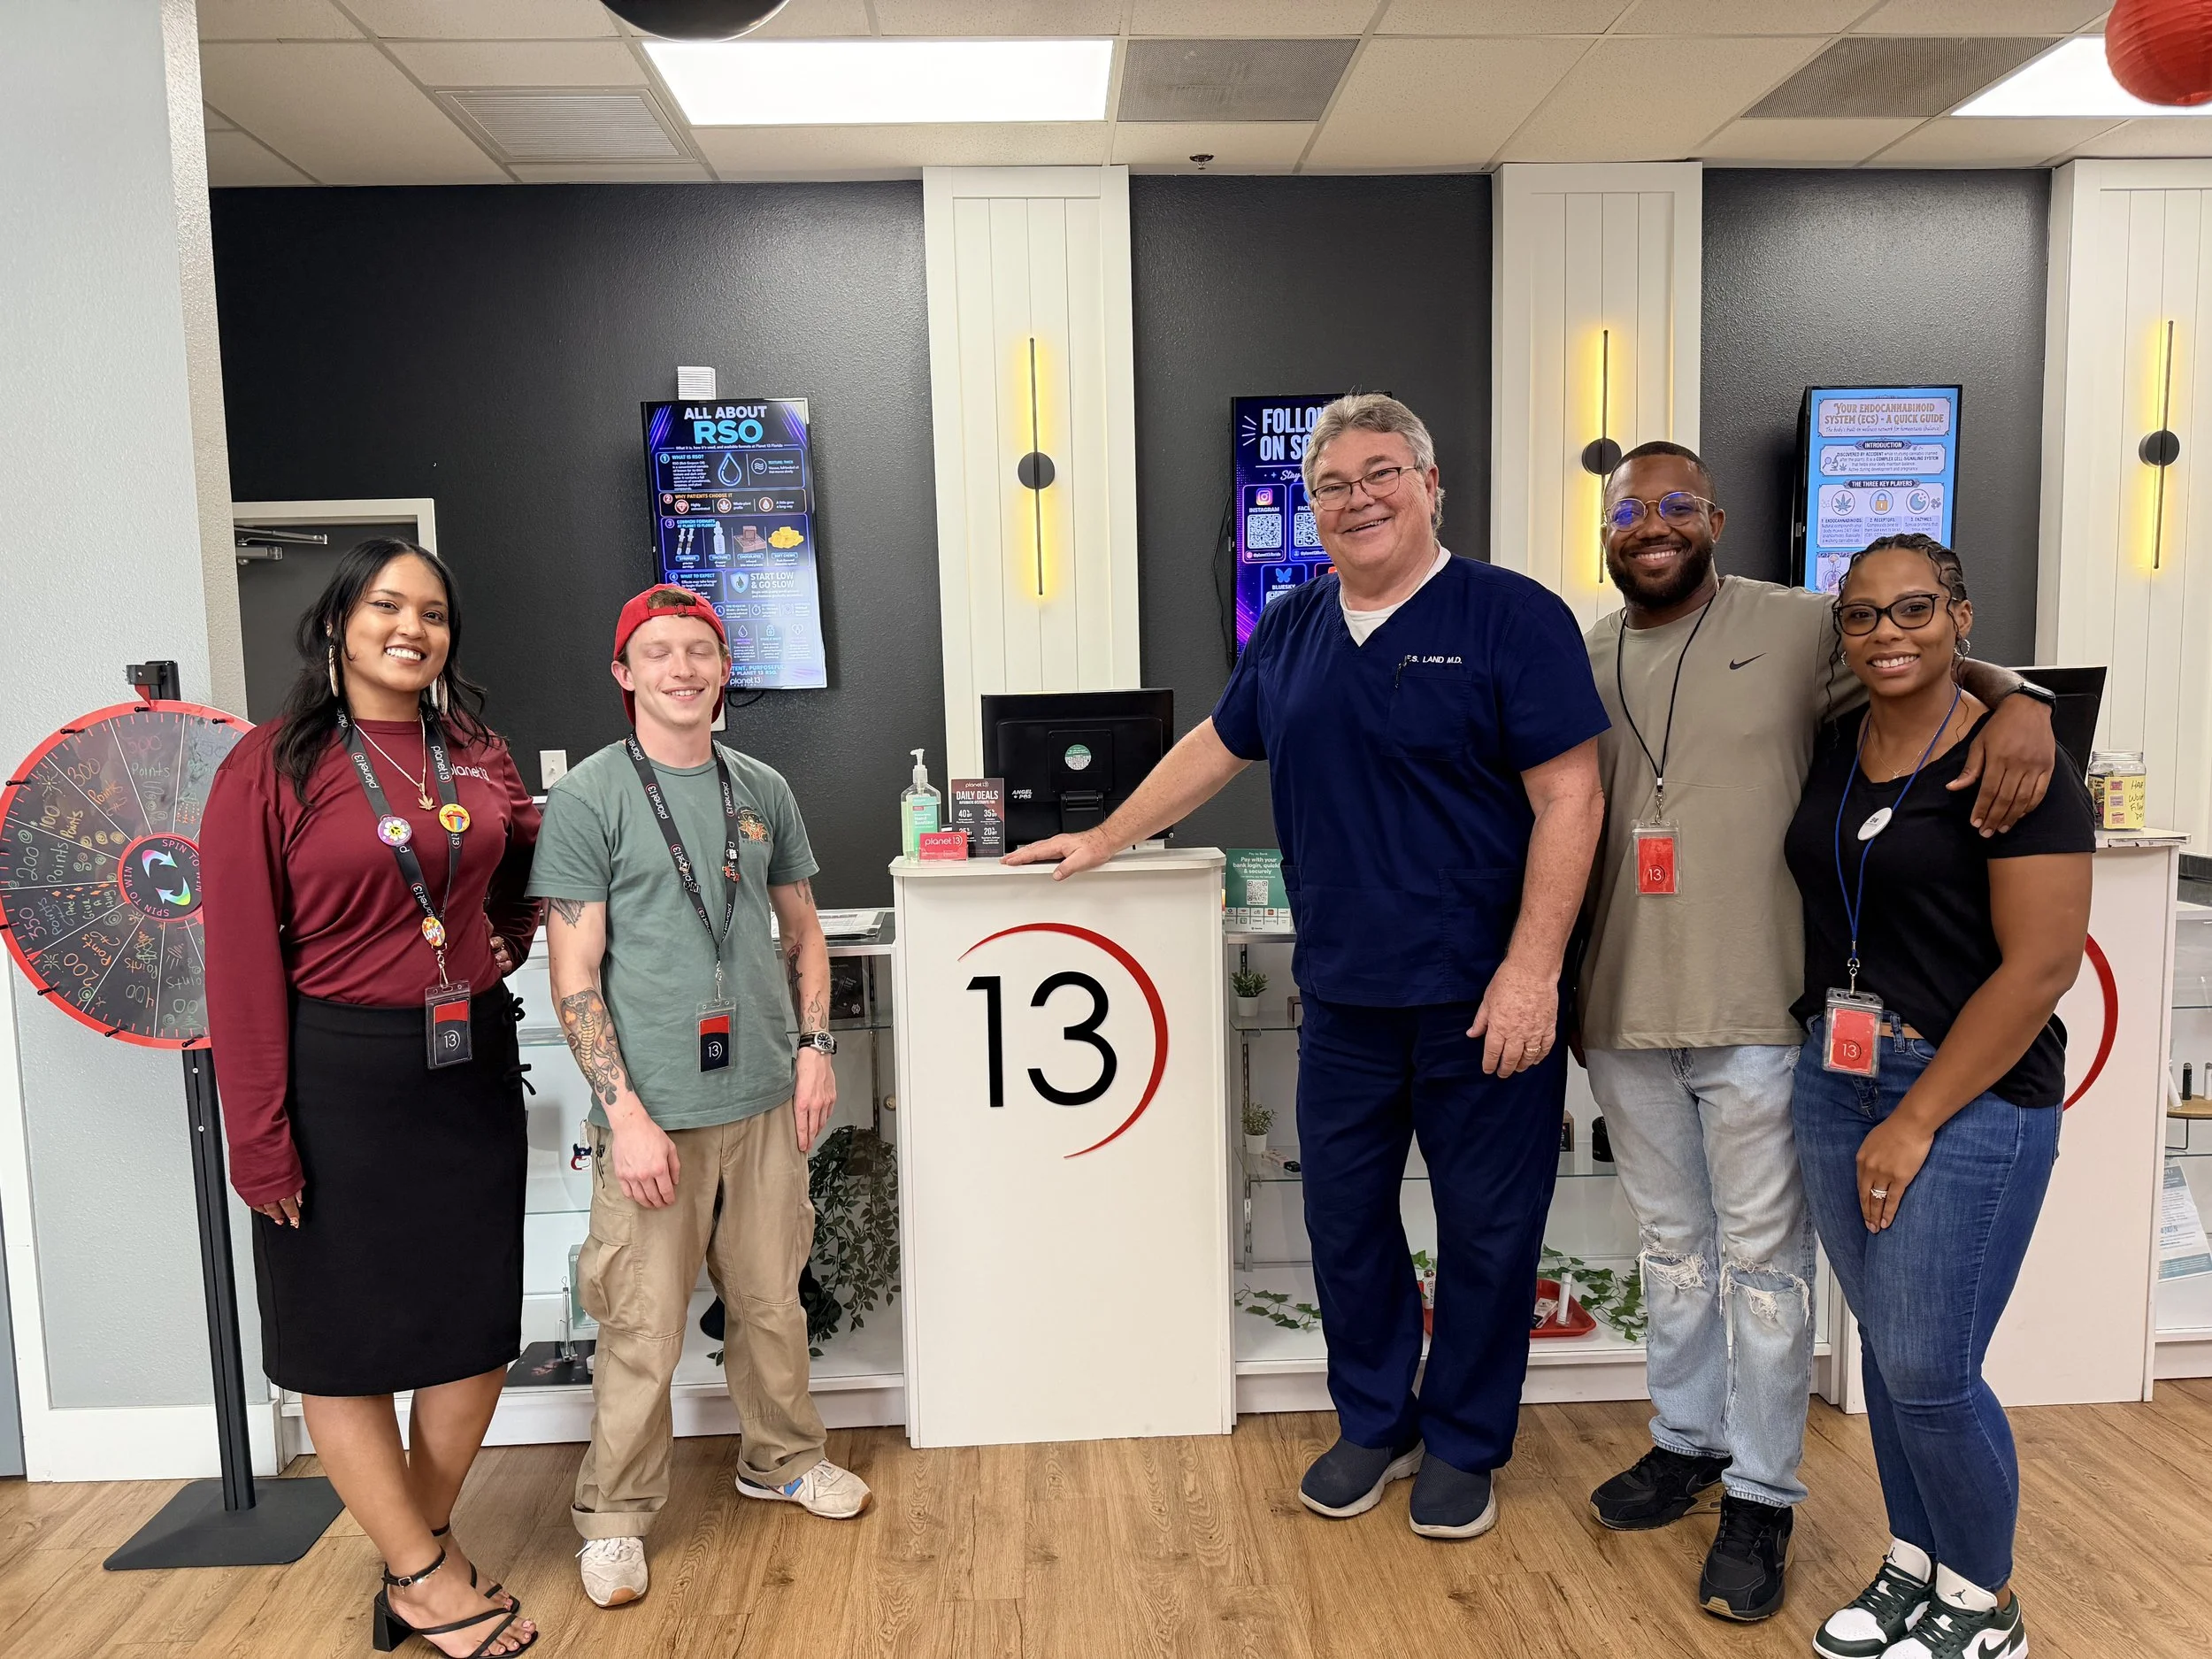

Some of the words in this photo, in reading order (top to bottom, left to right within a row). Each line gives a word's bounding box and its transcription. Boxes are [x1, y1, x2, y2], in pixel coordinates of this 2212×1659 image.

[684, 408, 711, 419] ALL
[715, 406, 767, 419] ABOUT
[1834, 403, 1857, 414] YOUR
[1860, 403, 1934, 413] ENDOCANNABINOID
[1824, 415, 1855, 424] SYSTEM
[1858, 414, 1879, 425] (ECS)
[1893, 414, 1918, 425] QUICK
[1920, 414, 1944, 423] GUIDE
[694, 419, 764, 444] RSO
[1260, 435, 1284, 461] ON
[1280, 470, 1302, 482] Stay
[67, 758, 100, 787] 300
[131, 762, 170, 778] Points
[956, 791, 976, 800] DAILY
[977, 791, 998, 800] DEALS
[162, 840, 187, 853] SPIN
[188, 853, 199, 866] TO
[16, 847, 39, 880] 200
[47, 842, 69, 883] Points
[124, 866, 133, 887] WIN
[1648, 869, 1662, 881] 13
[130, 893, 142, 905] TO
[144, 904, 170, 917] SPIN
[425, 928, 440, 940] LOVE
[165, 976, 202, 989] oints
[126, 985, 154, 1009] 400
[173, 999, 198, 1014] 00
[443, 1034, 457, 1049] 13
[966, 971, 1118, 1108] 13
[708, 1044, 718, 1058] 13
[1841, 1042, 1857, 1058] 13
